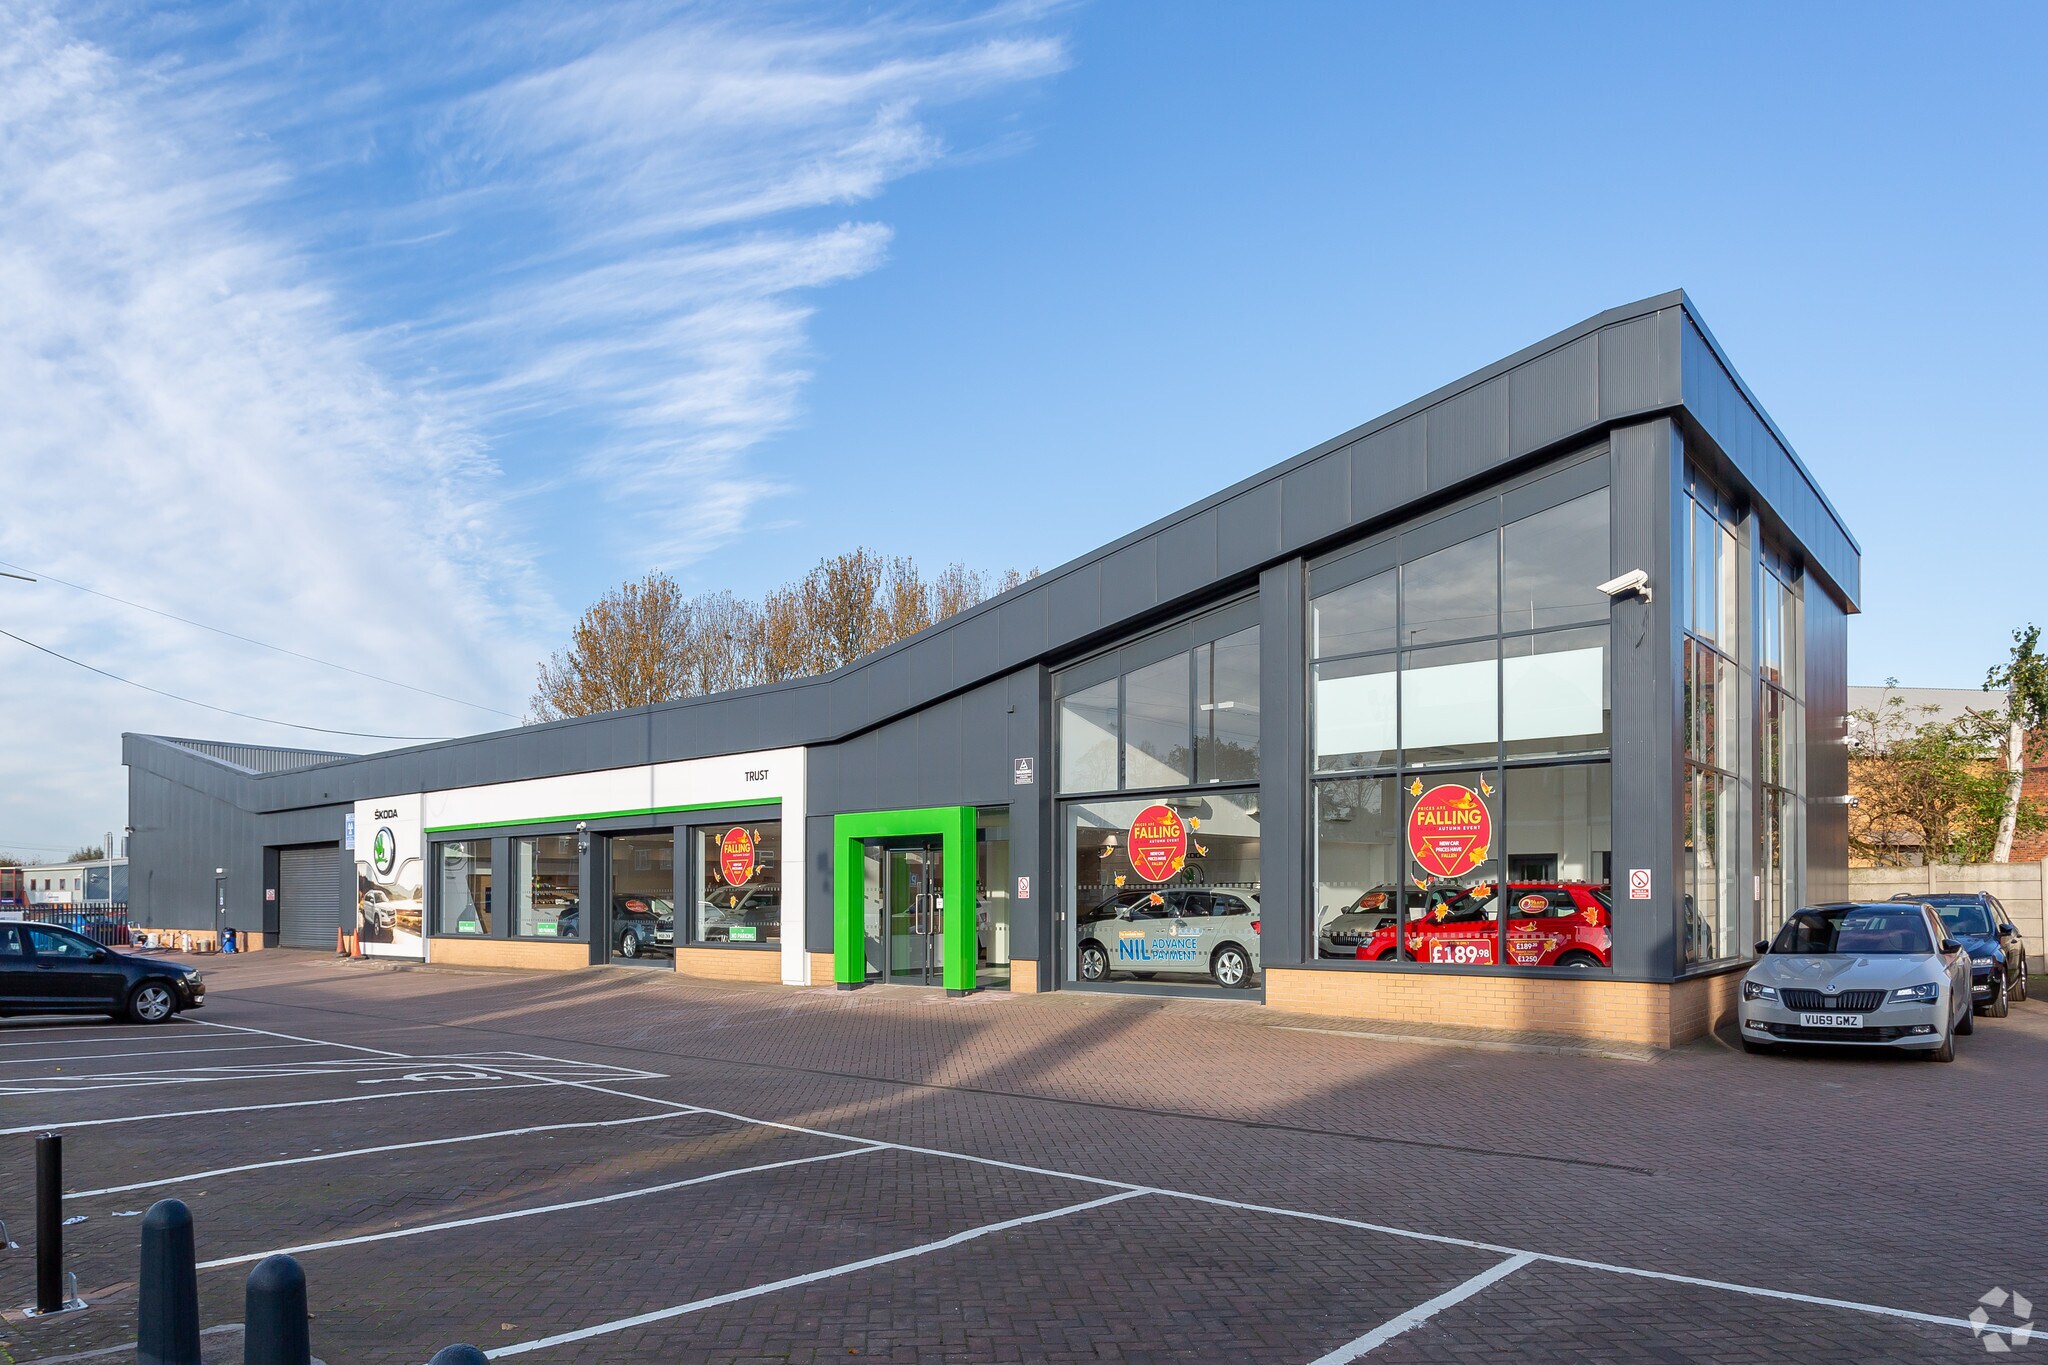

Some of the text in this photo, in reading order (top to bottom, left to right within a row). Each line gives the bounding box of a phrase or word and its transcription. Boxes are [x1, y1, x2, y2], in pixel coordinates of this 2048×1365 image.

[744, 769, 769, 782] TRUST
[374, 809, 398, 820] ŠKODA
[1417, 809, 1482, 826] FALLING
[1134, 825, 1180, 839] FALLING
[724, 843, 750, 854] FALLING
[1119, 938, 1197, 961] NIL ADVANCE
[1152, 950, 1197, 961] PAYMENT
[1432, 945, 1490, 964] £189.98
[1805, 1014, 1858, 1026] VU69 GMZ
